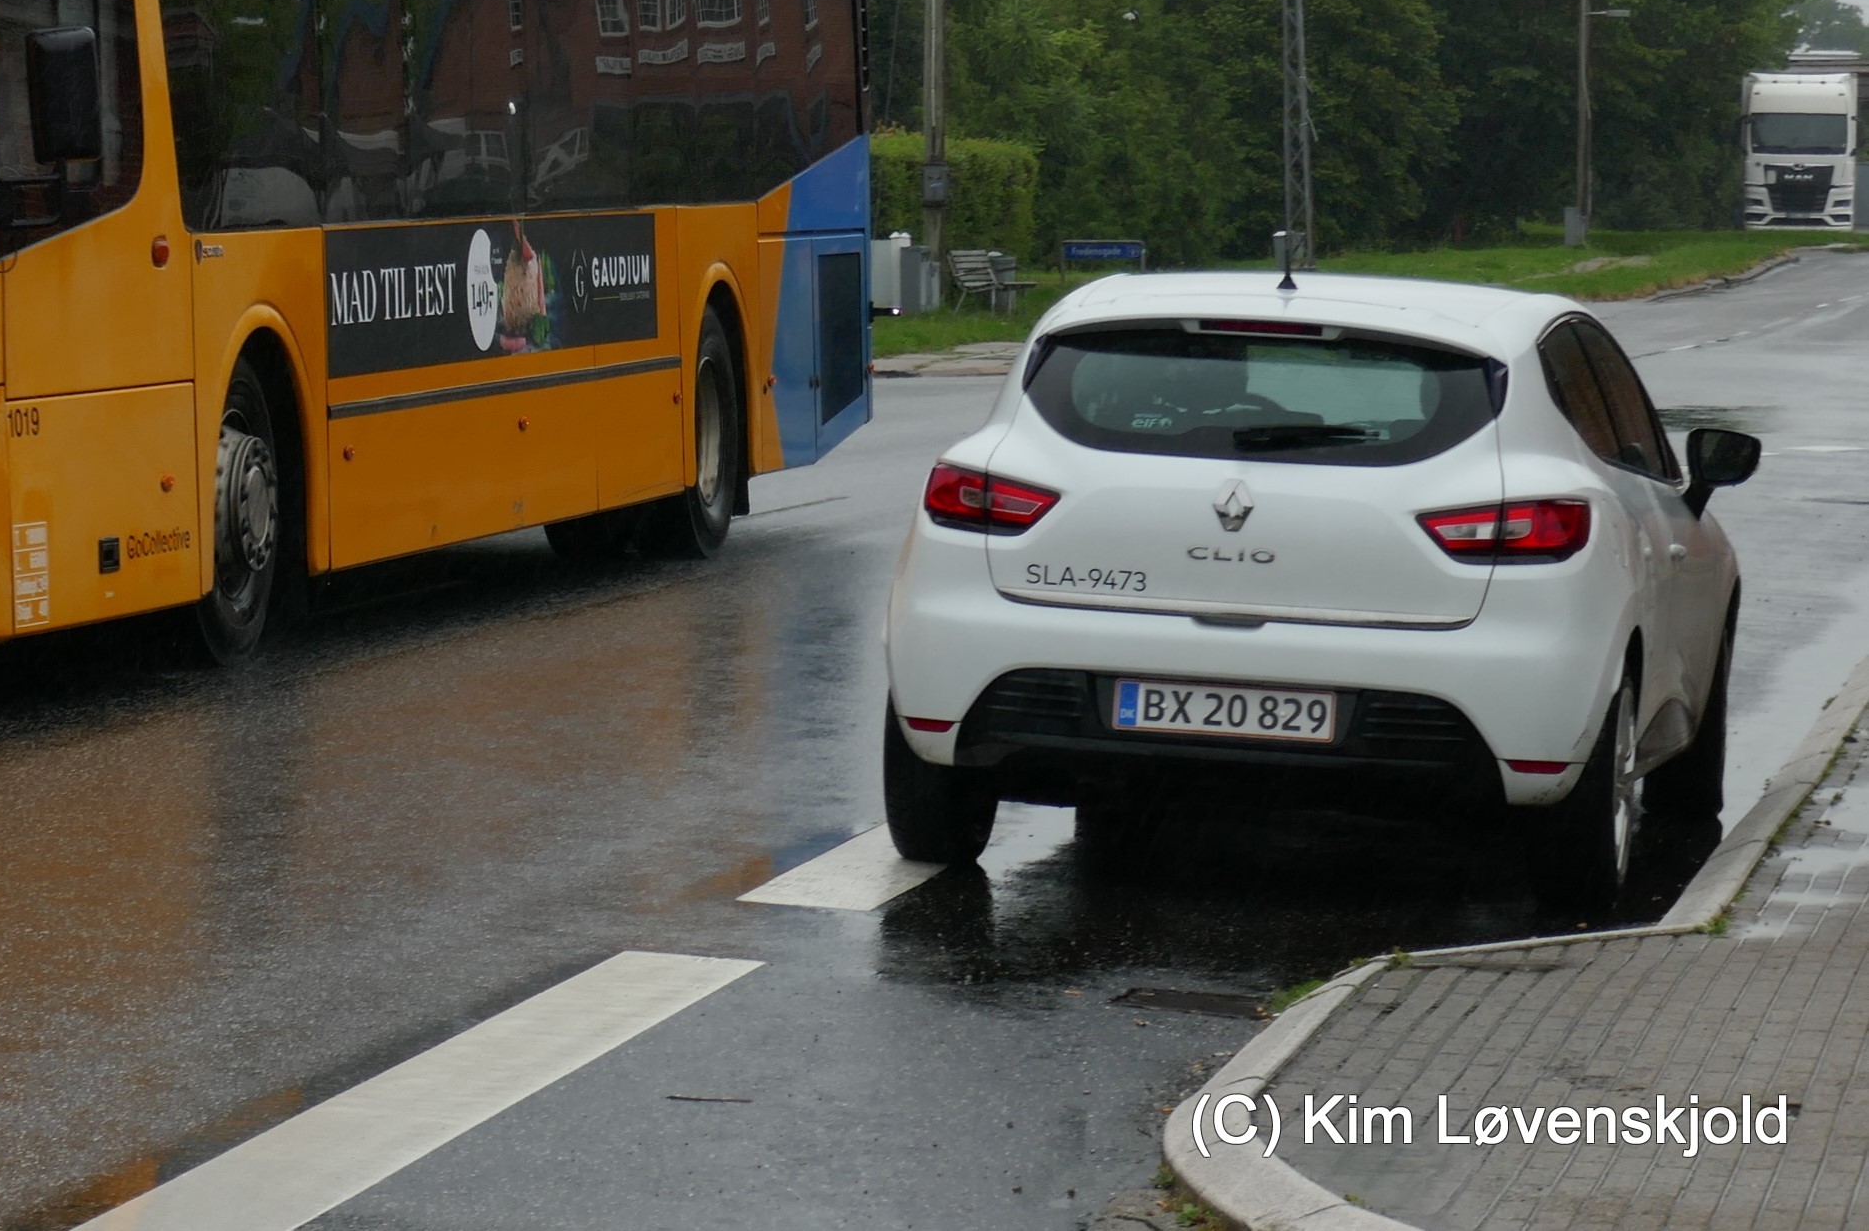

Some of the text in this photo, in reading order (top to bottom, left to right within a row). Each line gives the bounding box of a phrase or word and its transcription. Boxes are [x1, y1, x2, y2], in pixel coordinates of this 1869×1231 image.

[591, 254, 650, 288] GAUDIUM
[330, 263, 456, 326] MAD TIL FEST
[7, 407, 40, 437] 1019
[126, 526, 191, 559] GoCollective
[1187, 545, 1275, 564] CLIO
[1026, 563, 1147, 592] SLA-9473
[1143, 689, 1193, 724] BX
[1203, 692, 1248, 728] 20
[1258, 695, 1328, 734] 829
